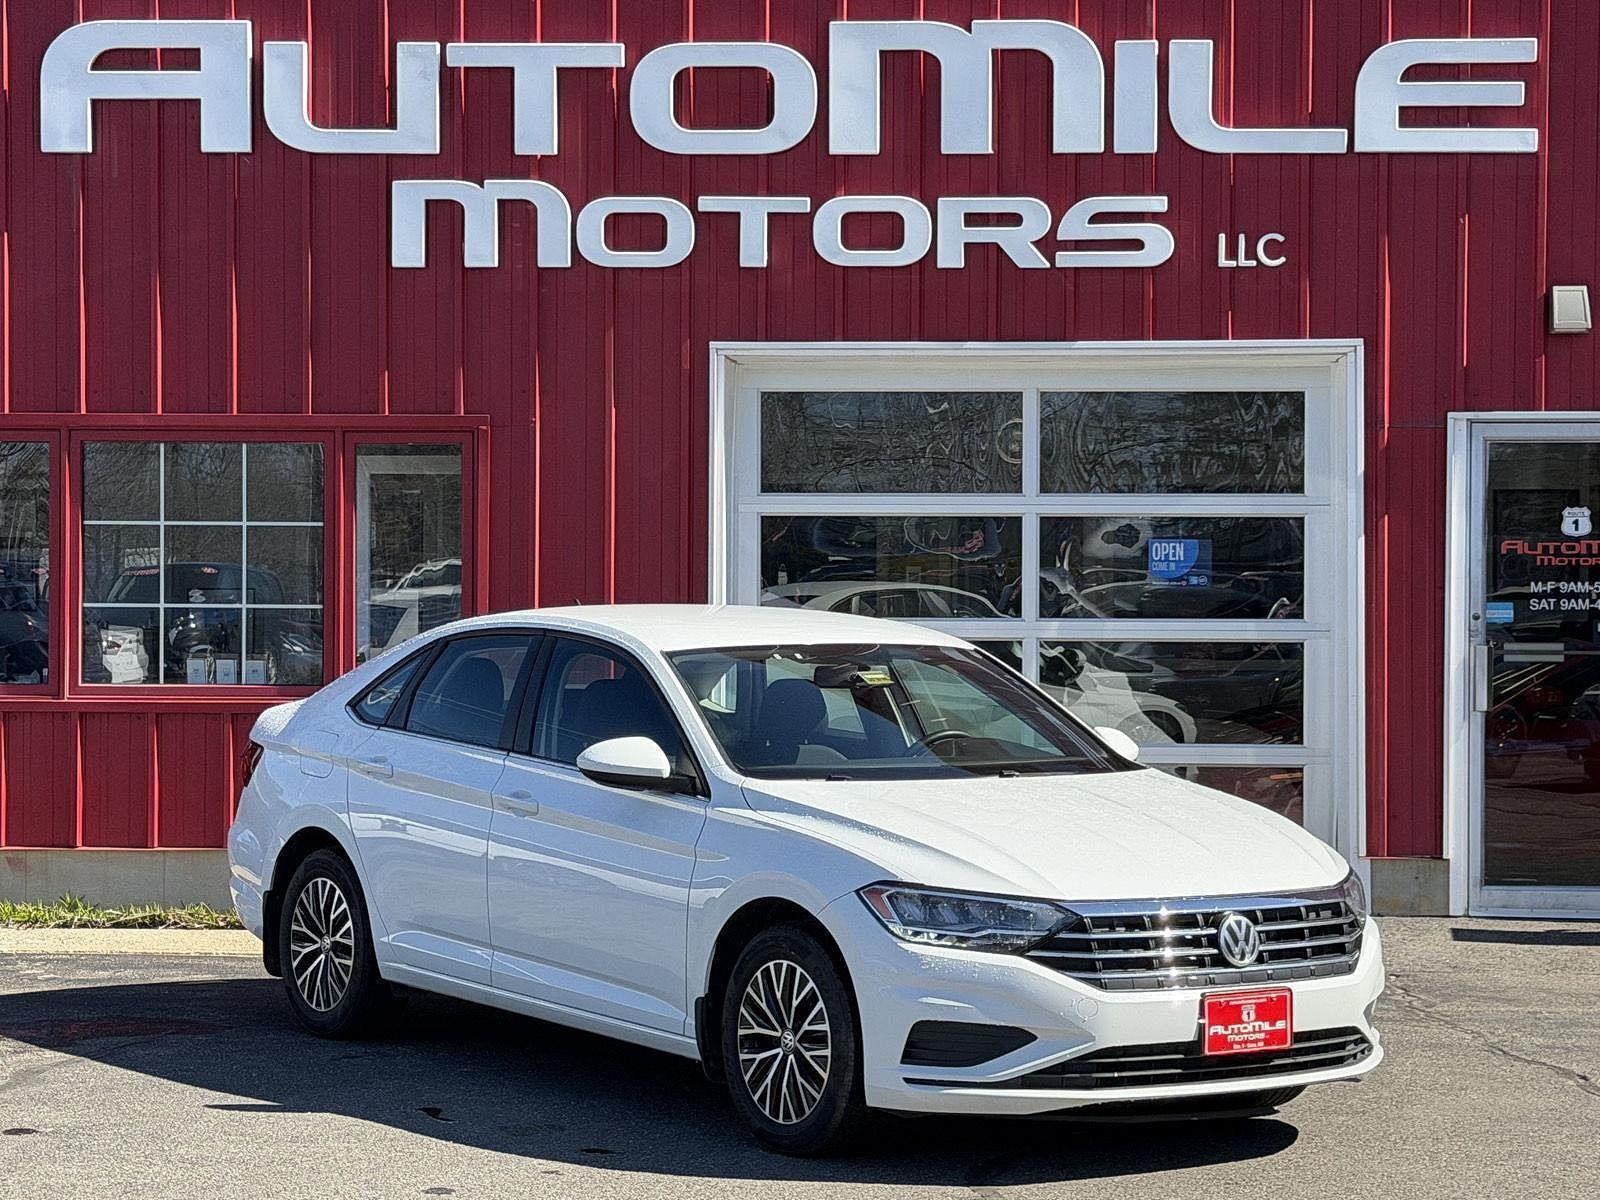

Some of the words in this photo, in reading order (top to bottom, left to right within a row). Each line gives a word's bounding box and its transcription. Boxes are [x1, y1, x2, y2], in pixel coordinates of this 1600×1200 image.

[40, 20, 1538, 156] AUTOMILE
[392, 180, 1174, 269] MOTORS
[1217, 233, 1286, 268] LLC
[1572, 518, 1579, 532] 1
[1152, 542, 1184, 560] OPEN
[1530, 581, 1556, 593] M-F
[1530, 598, 1557, 610] SAT
